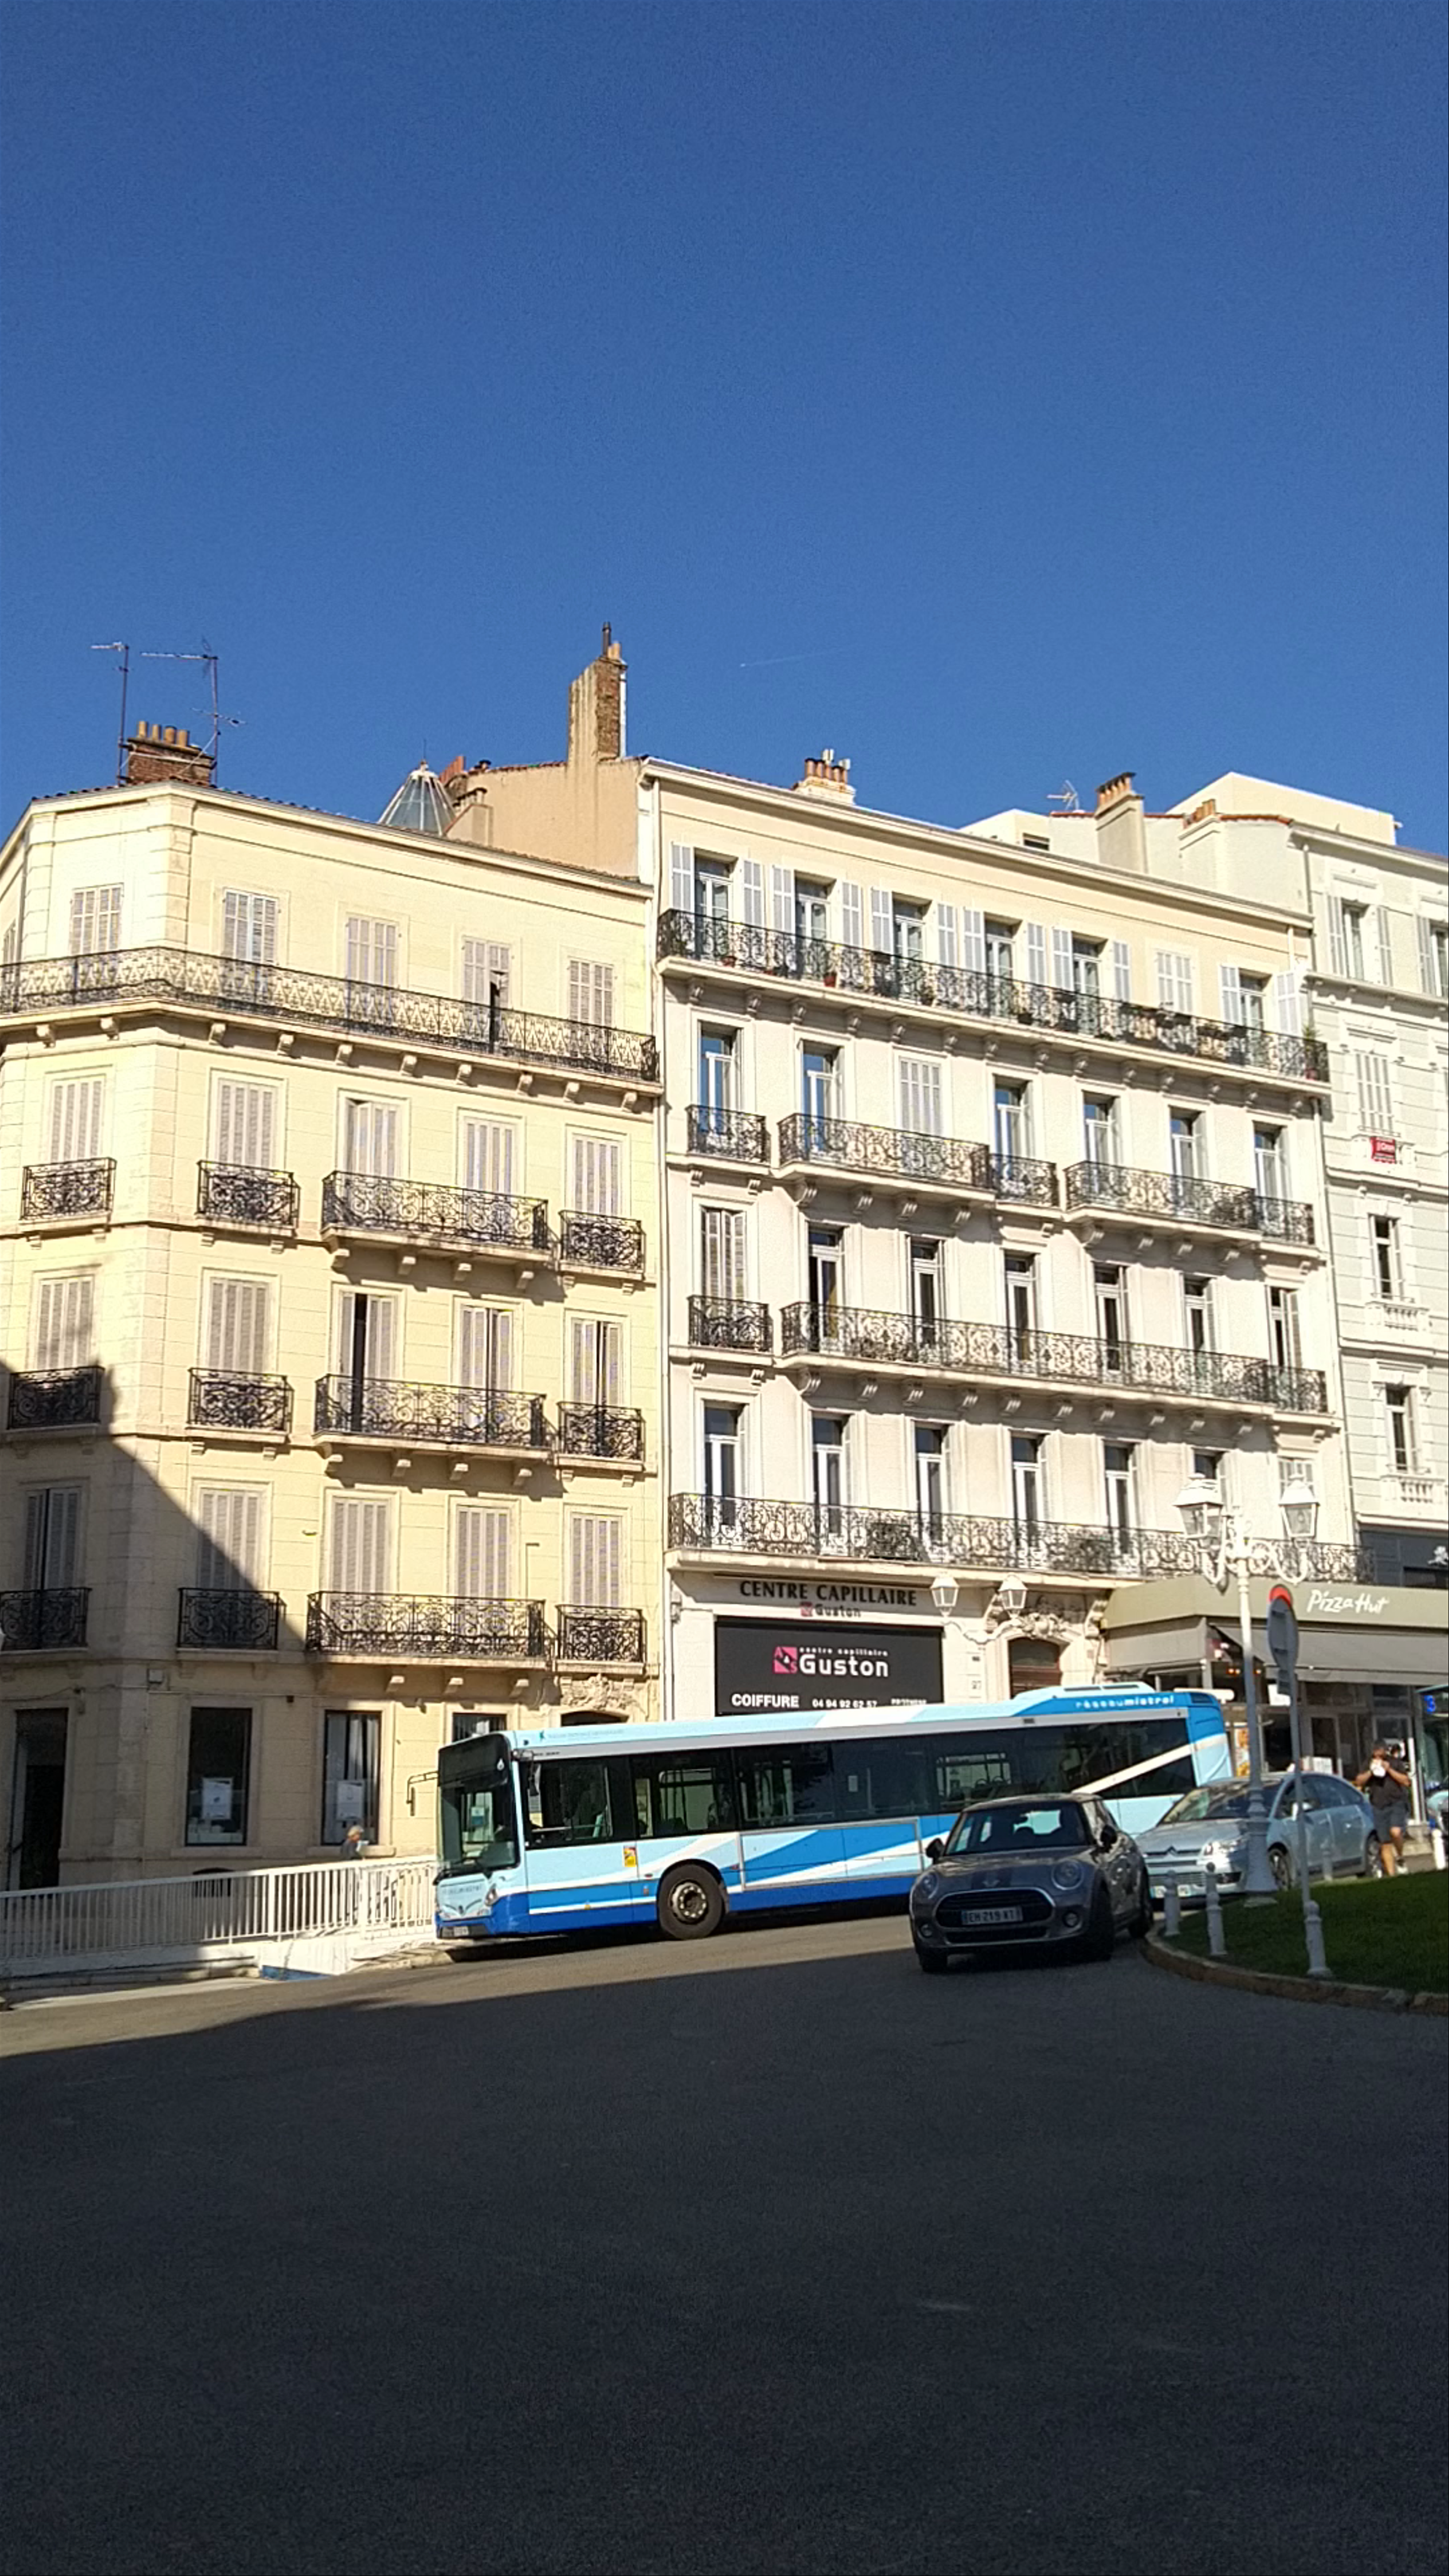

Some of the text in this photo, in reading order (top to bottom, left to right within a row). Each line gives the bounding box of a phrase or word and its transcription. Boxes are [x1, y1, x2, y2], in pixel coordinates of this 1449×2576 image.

[740, 1581, 917, 1606] CENTRE CAPILLAIRE
[1307, 1589, 1390, 1613] Pizza Hut
[815, 1604, 862, 1618] Guston
[838, 1647, 888, 1657] capillaire
[799, 1654, 888, 1677] Guston
[731, 1694, 800, 1708] COIFFURE
[812, 1698, 824, 1708] 04
[826, 1699, 837, 1708] 94
[839, 1699, 851, 1708] 92
